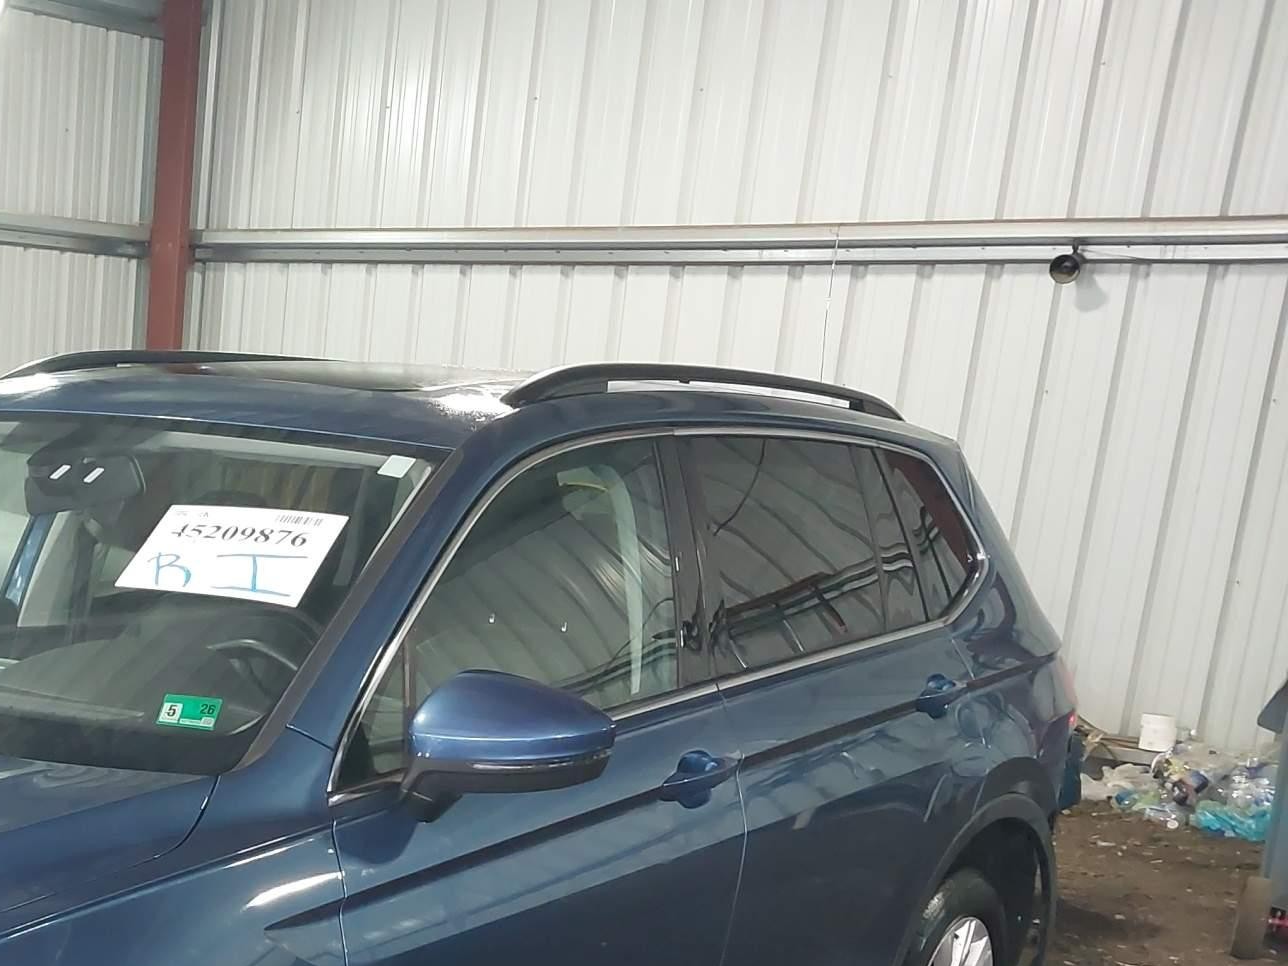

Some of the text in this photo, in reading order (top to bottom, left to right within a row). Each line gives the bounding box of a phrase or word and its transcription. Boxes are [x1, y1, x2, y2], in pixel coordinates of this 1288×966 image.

[171, 523, 311, 548] 45209876
[165, 703, 217, 717] 5 26
